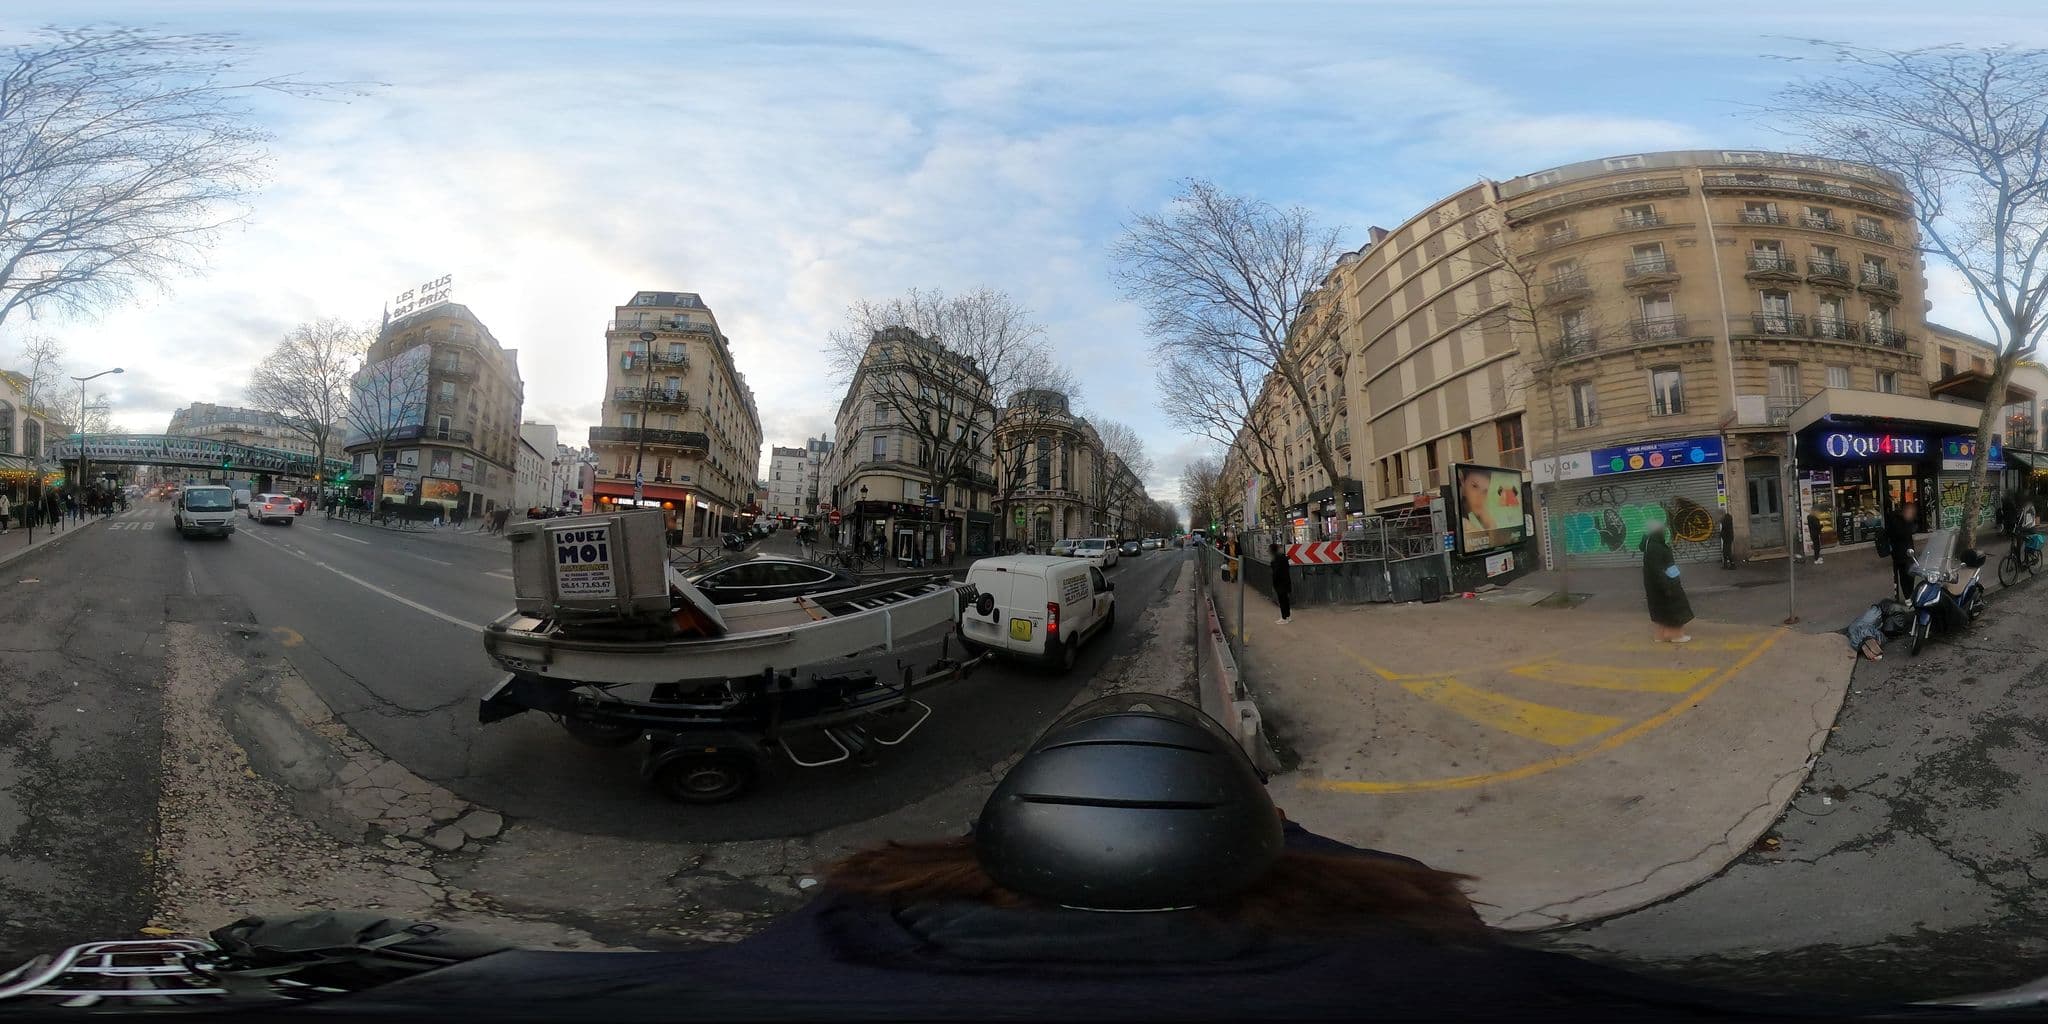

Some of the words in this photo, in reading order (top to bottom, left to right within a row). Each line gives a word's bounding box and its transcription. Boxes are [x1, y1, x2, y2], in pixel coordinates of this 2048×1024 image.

[396, 289, 414, 304] LES
[421, 274, 452, 293] PLUS
[394, 301, 415, 318] BAS
[418, 288, 450, 307] PRIX
[1543, 461, 1571, 475] Lya
[556, 529, 606, 544] LOUEZ
[558, 543, 608, 564] MOI
